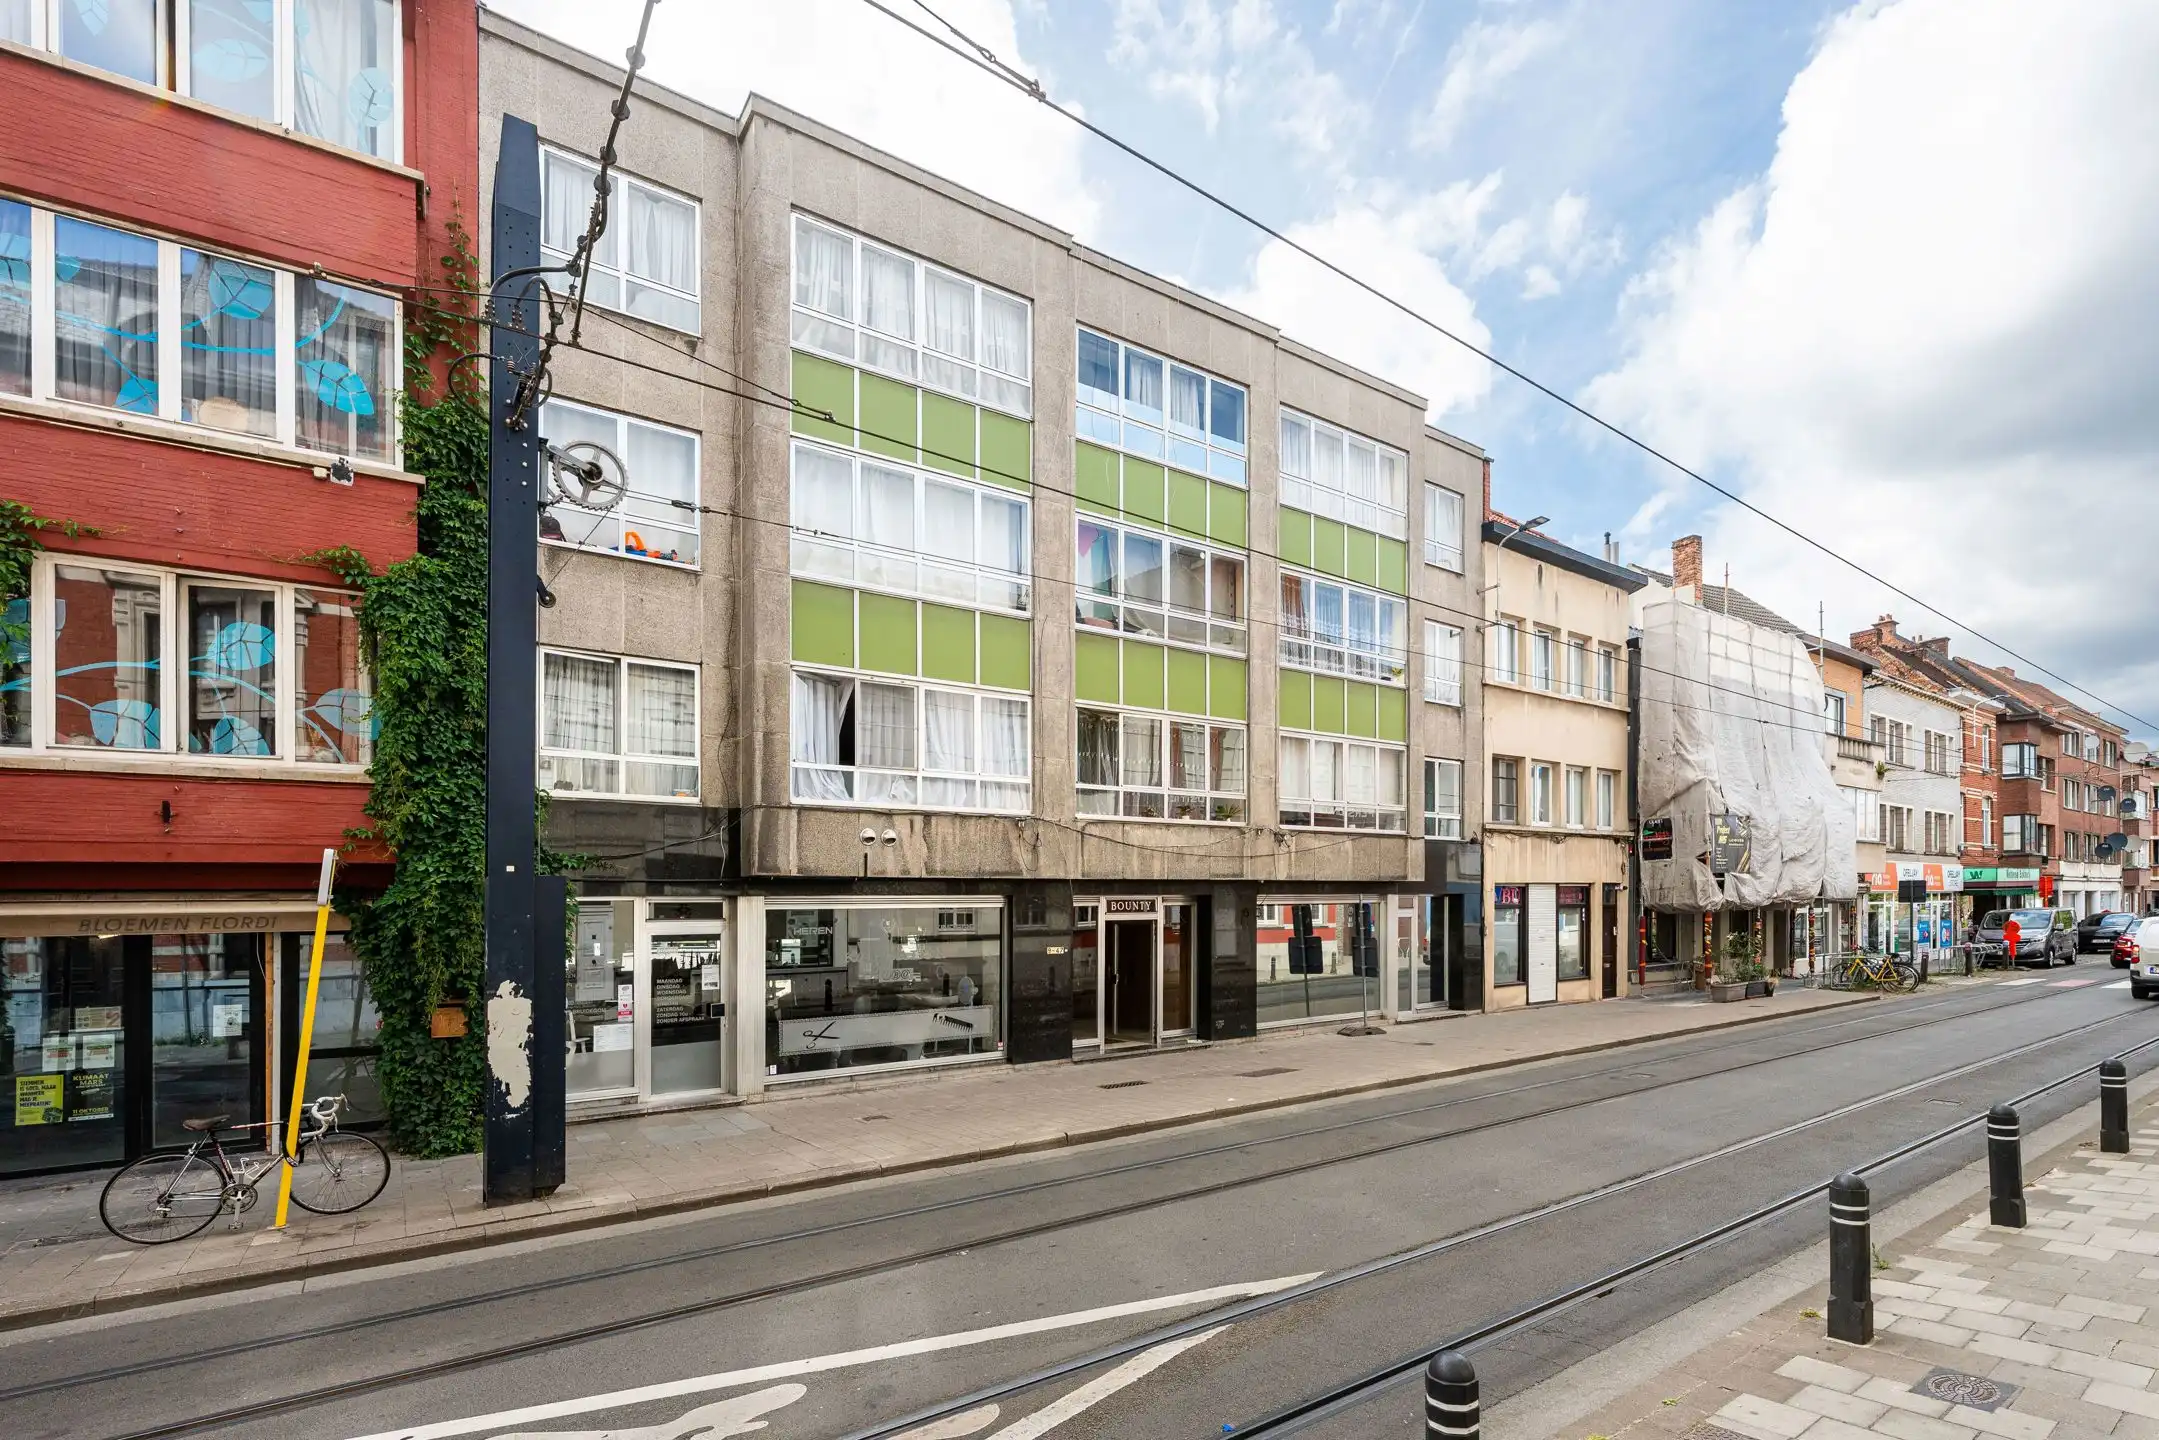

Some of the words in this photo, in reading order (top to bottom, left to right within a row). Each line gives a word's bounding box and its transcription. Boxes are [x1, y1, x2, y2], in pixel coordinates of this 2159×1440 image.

[1111, 901, 1152, 911] BOUNTY
[77, 917, 190, 933] BLOEMEN
[200, 916, 279, 930] FLORDI
[793, 926, 833, 936] HEREN
[72, 1073, 109, 1081] KLIMAAT
